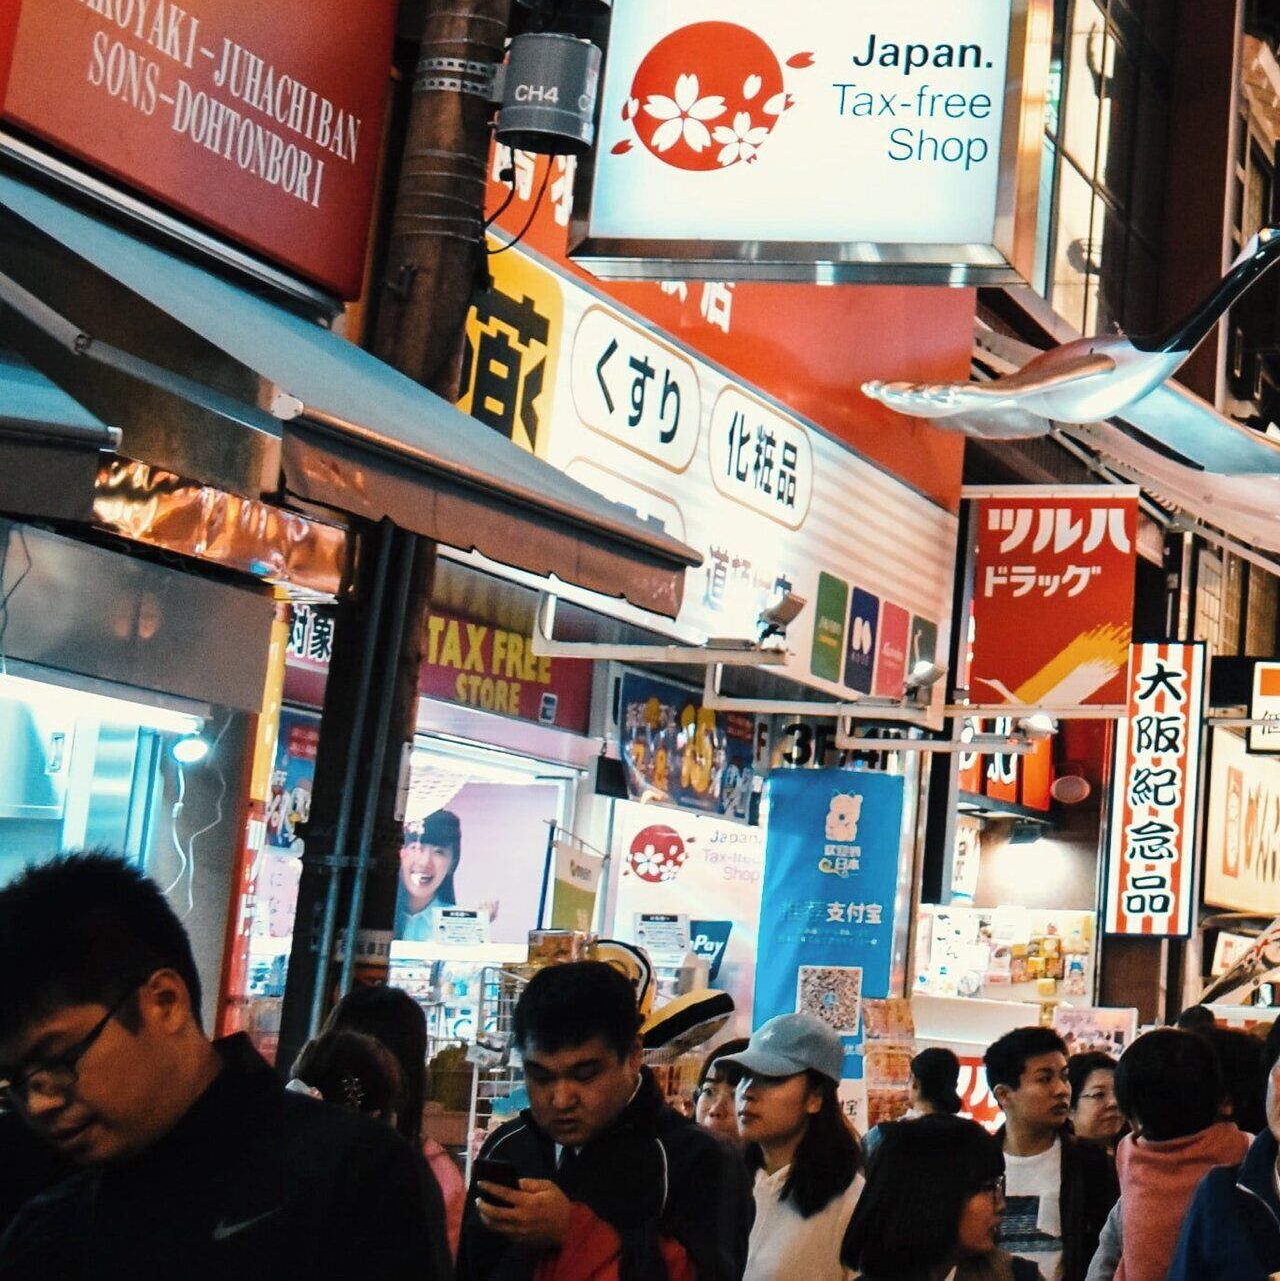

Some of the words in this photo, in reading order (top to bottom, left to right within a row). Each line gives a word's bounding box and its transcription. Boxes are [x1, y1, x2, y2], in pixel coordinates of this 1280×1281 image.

[852, 34, 994, 76] Japan.
[514, 83, 559, 103] CH4
[832, 83, 992, 119] Tax-free
[887, 128, 989, 170] Shop
[595, 337, 682, 444] くすり
[727, 410, 799, 508] 化粧品
[987, 508, 1130, 553] ツルハ
[984, 564, 1101, 598] ドラッグ
[427, 615, 488, 673] TAX
[455, 671, 521, 717] STORE
[1121, 661, 1186, 918] 大阪紀念品
